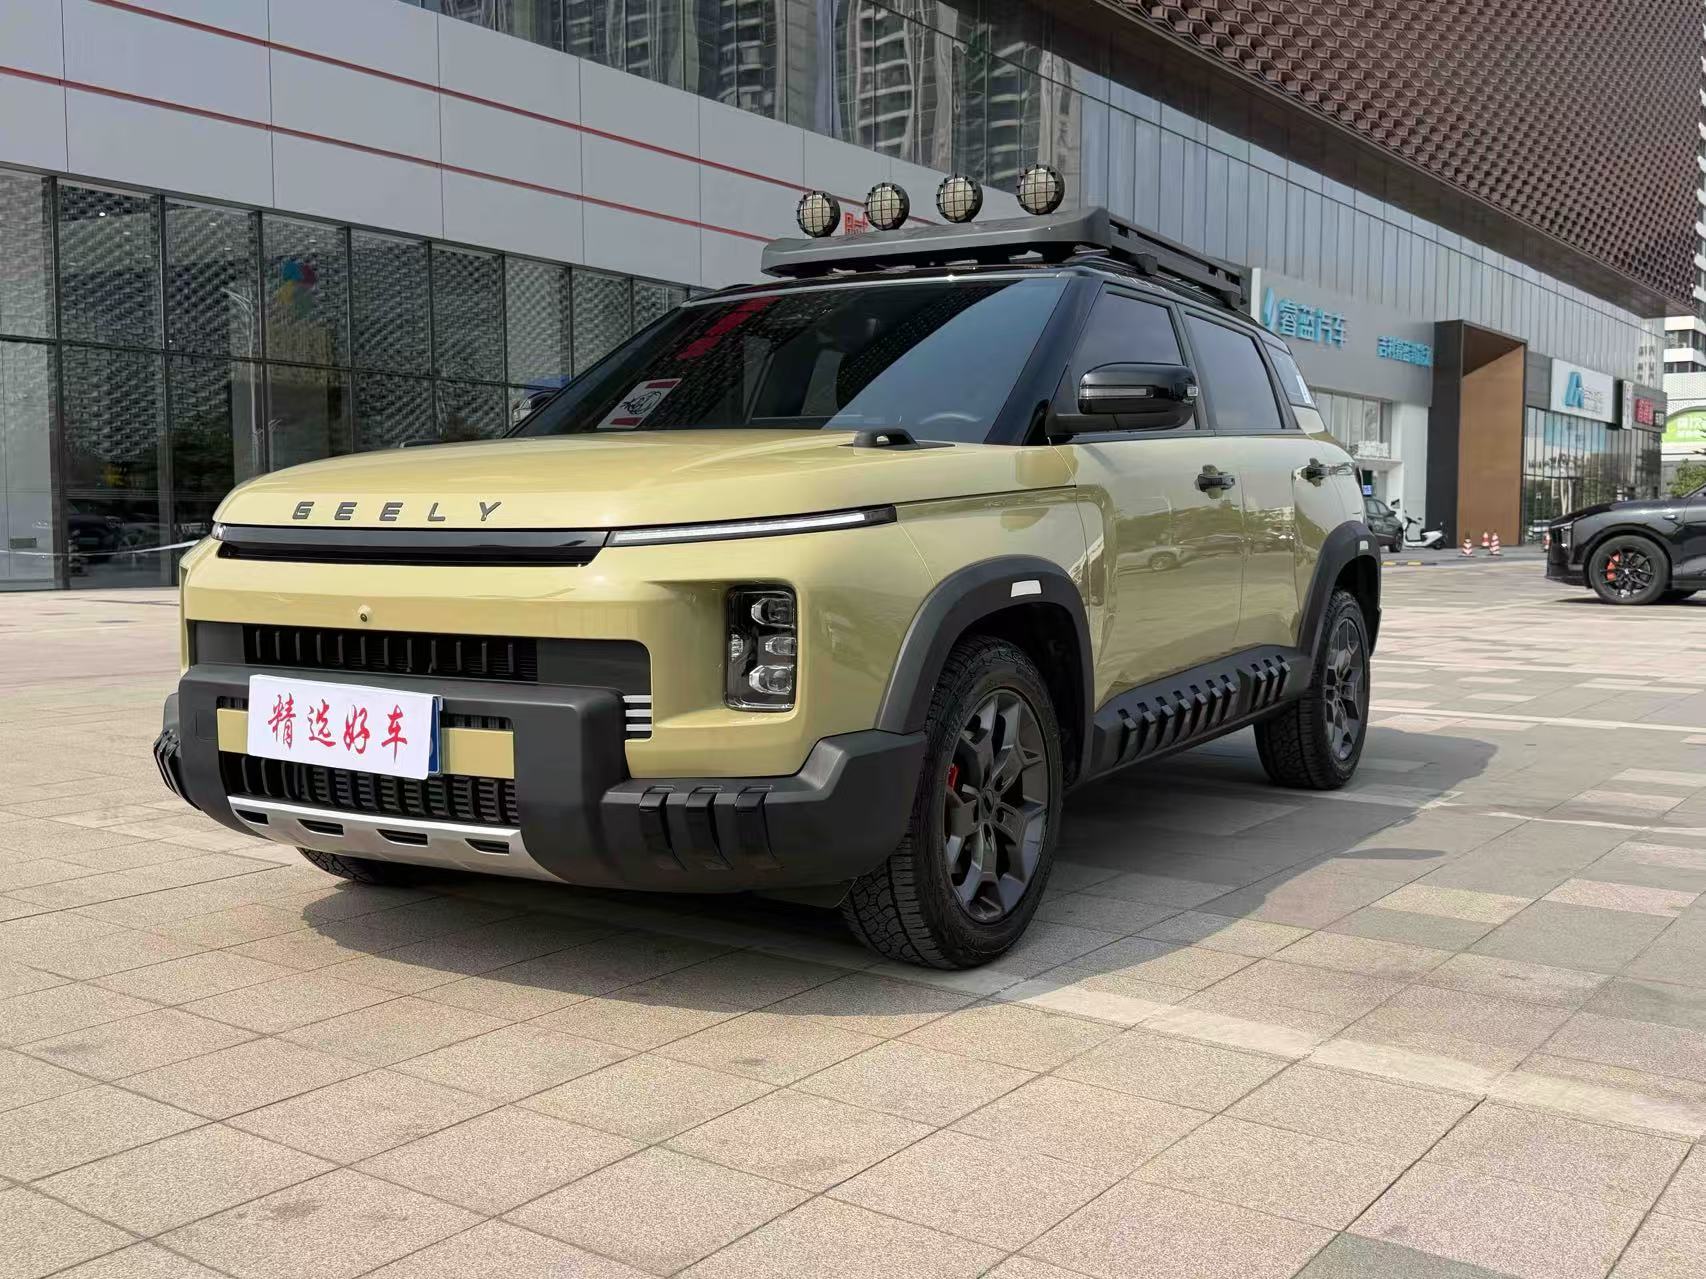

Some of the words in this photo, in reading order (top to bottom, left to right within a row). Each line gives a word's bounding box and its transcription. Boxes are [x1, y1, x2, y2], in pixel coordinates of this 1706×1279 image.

[292, 501, 502, 522] GEELY
[267, 693, 408, 763] 精选好车
